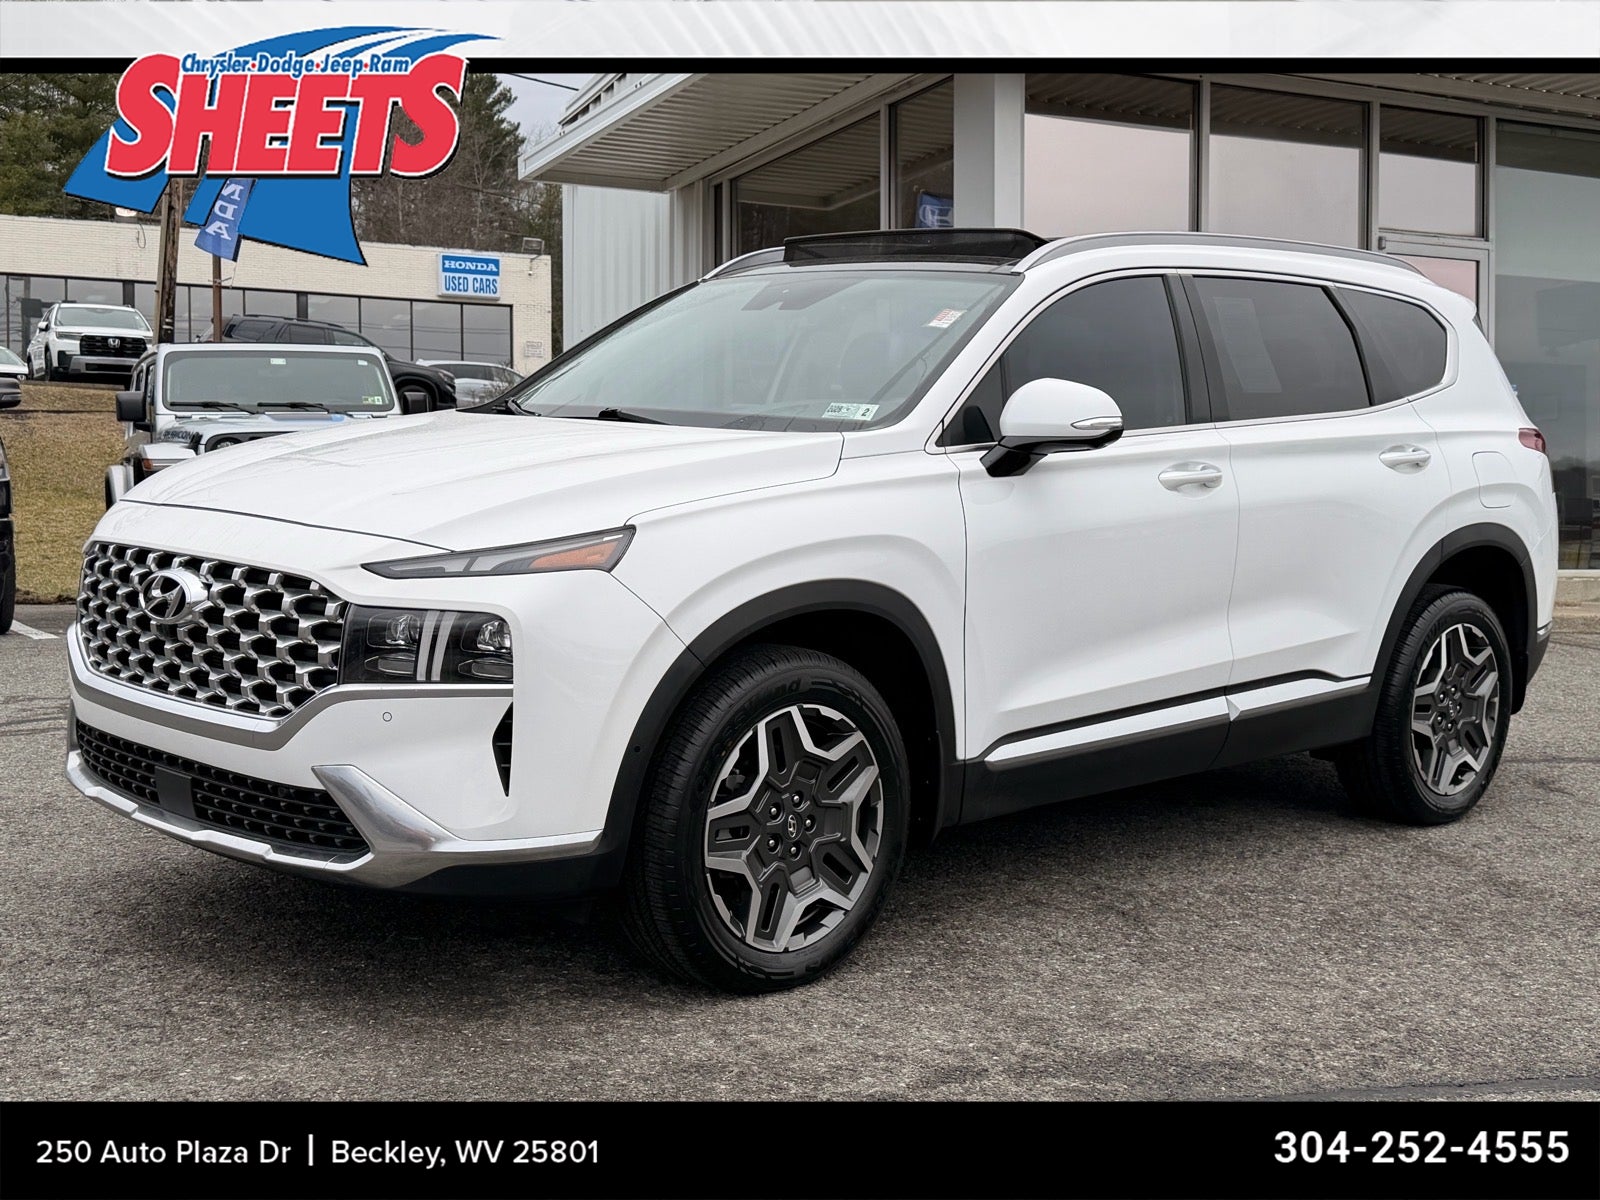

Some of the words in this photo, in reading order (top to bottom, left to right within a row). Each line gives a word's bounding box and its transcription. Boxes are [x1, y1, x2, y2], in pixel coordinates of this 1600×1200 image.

[443, 260, 498, 272] HONDA
[444, 275, 469, 292] USED
[472, 278, 498, 294] CARS
